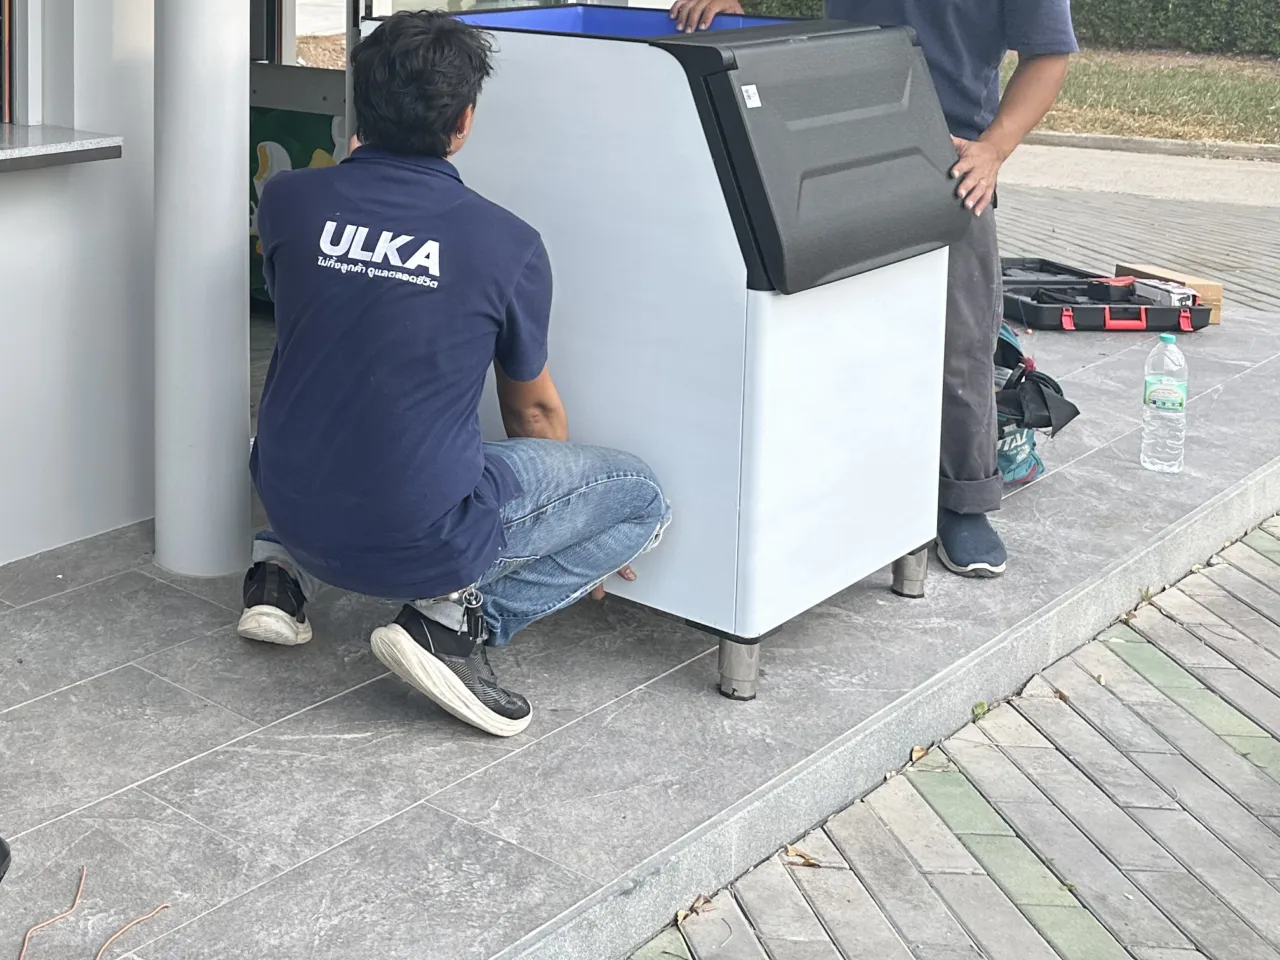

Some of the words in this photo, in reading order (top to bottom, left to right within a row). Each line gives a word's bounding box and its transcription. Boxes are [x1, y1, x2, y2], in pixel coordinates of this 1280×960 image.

[319, 220, 441, 277] ULKA
[317, 256, 366, 274] ไม่ทิ้งลูกค้า
[367, 267, 439, 289] ดูแลตลอดชีวิต
